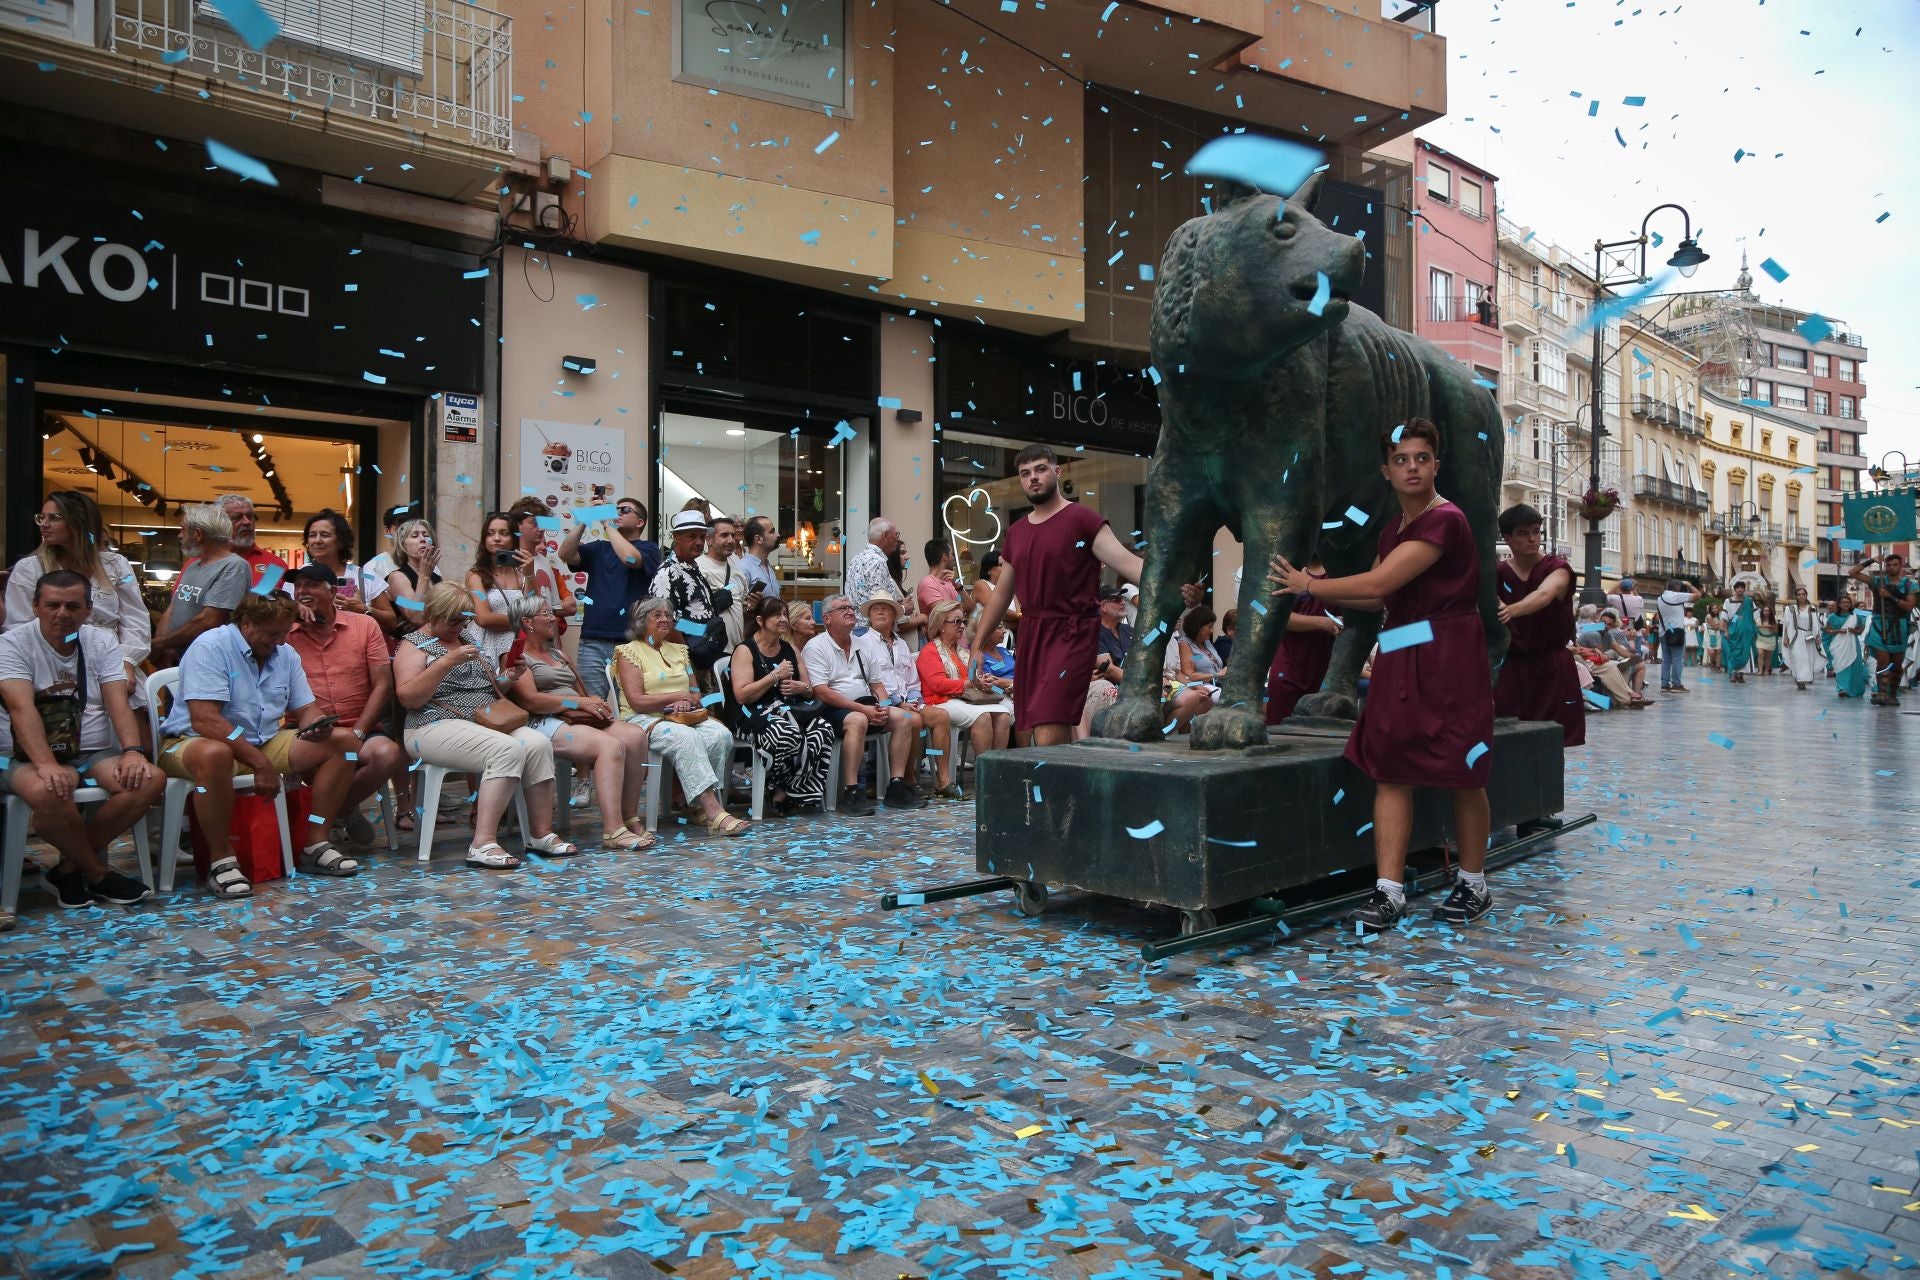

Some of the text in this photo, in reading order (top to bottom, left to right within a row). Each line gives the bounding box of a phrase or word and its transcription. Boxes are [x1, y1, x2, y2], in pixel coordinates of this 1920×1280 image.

[705, 0, 774, 39] Sandra
[0, 228, 149, 302] KO
[449, 396, 475, 406] tyco
[1053, 391, 1108, 426] BICO
[446, 412, 477, 423] Alarma
[576, 449, 611, 466] BICO
[576, 463, 611, 473] de xeado
